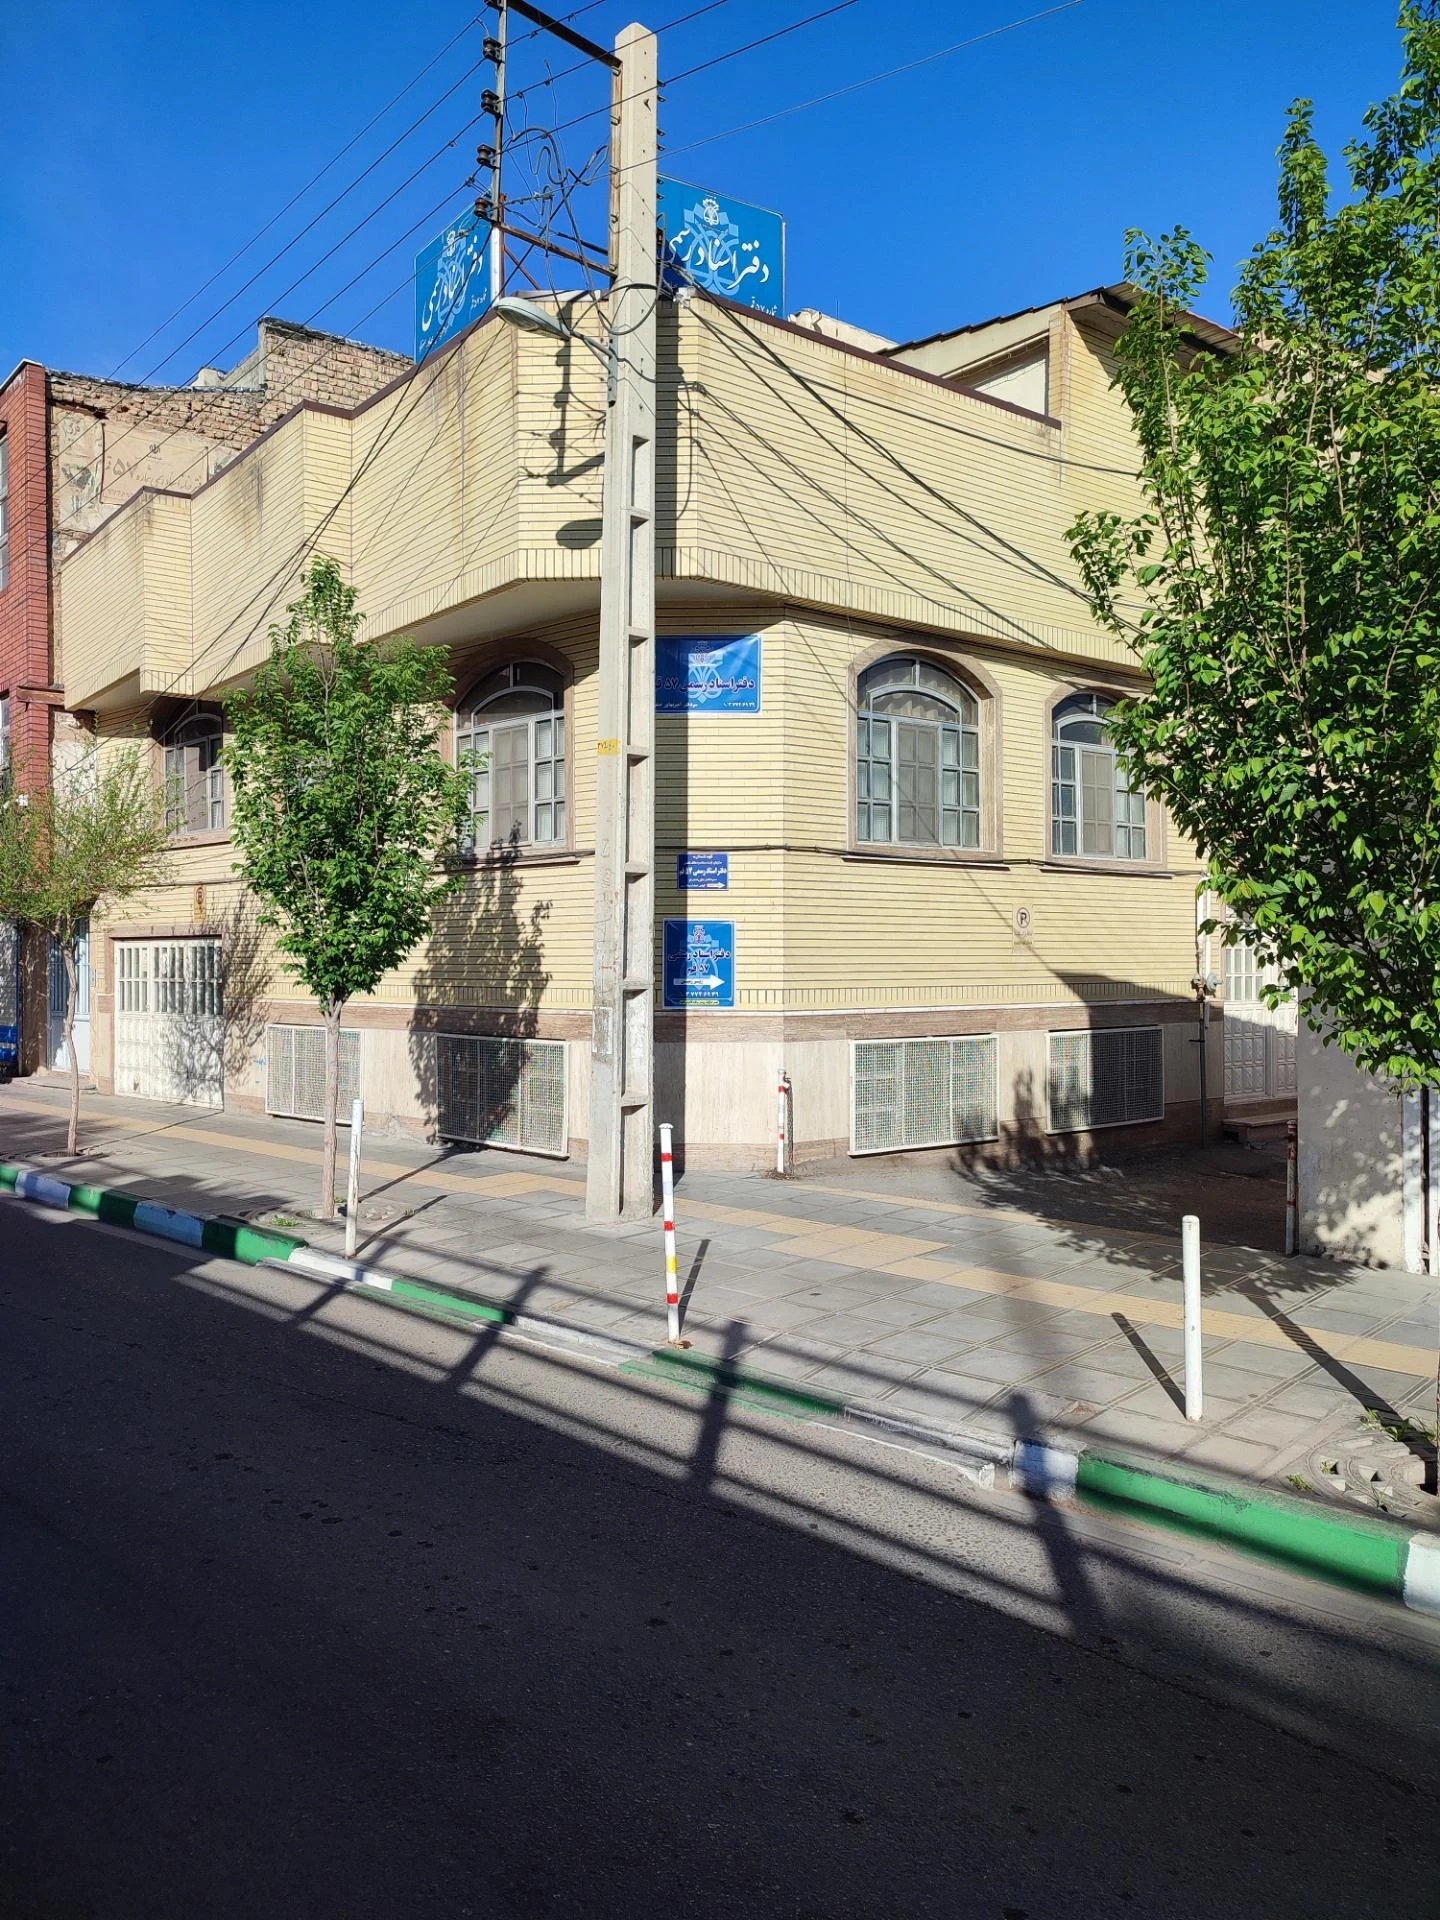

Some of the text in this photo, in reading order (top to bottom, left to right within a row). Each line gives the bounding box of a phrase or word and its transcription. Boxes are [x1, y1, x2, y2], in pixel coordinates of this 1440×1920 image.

[695, 238, 737, 271] اسناد
[726, 240, 770, 290] دفتر
[664, 676, 679, 690] ۵۷
[680, 681, 709, 694] رسمی
[709, 676, 734, 690] اسناد
[733, 676, 755, 694] دفتر
[692, 950, 713, 958] اسناد
[713, 948, 731, 962] دفتر
[699, 964, 710, 973] ۵۷
